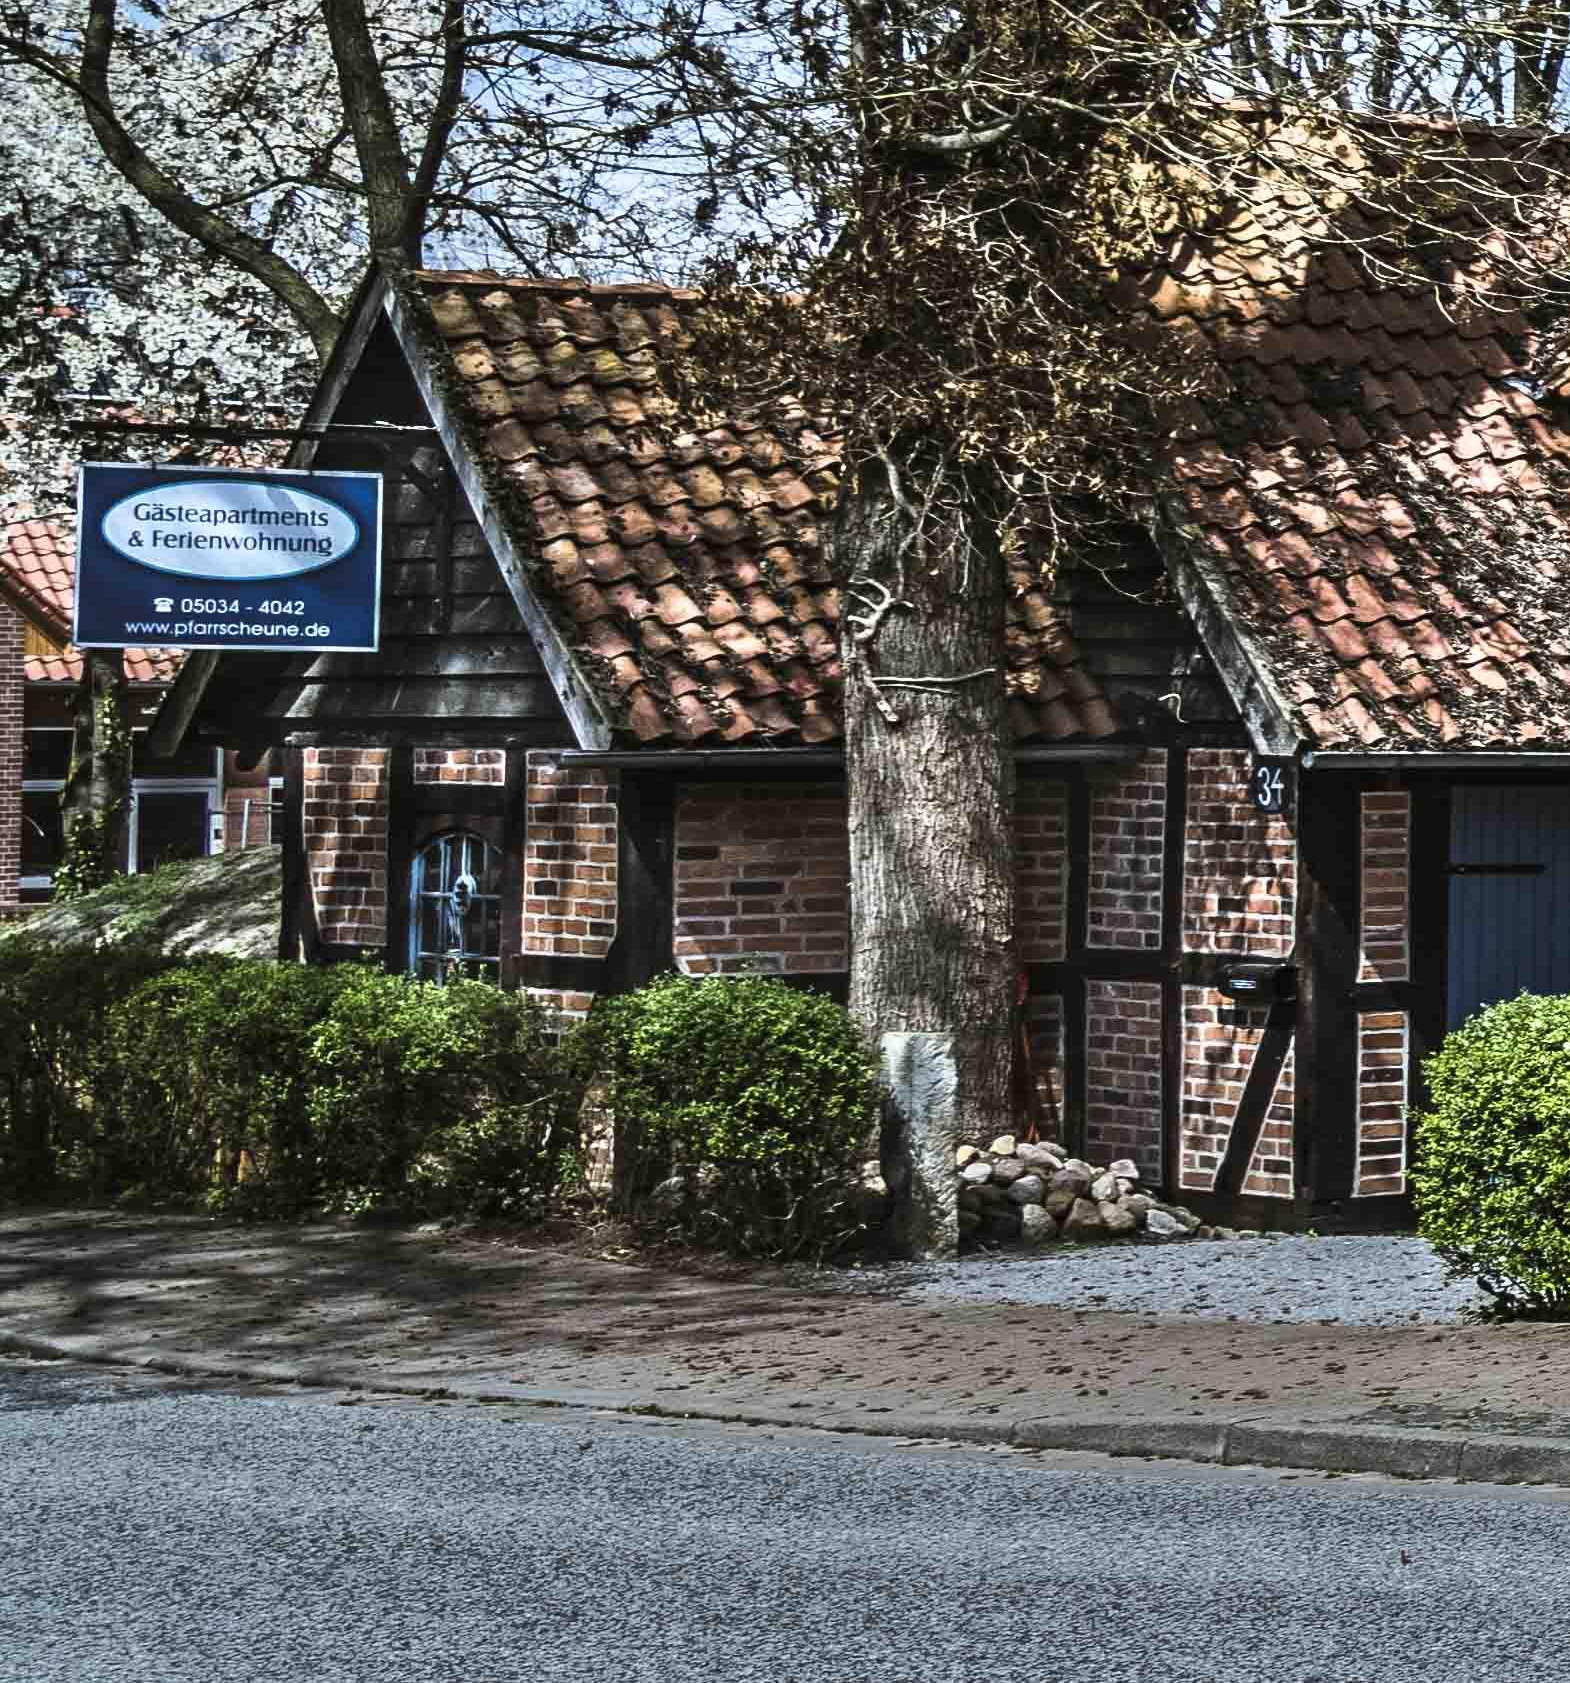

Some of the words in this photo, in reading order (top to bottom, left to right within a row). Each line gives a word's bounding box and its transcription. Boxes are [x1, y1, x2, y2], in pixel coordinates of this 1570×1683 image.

[133, 502, 329, 527] Gästeapartments
[128, 530, 145, 547] &
[152, 530, 333, 556] Ferienwohnung
[181, 598, 240, 614] 05034
[258, 600, 305, 615] 4042
[125, 621, 331, 638] www.pfarrscheune.de
[1257, 766, 1284, 806] 34
